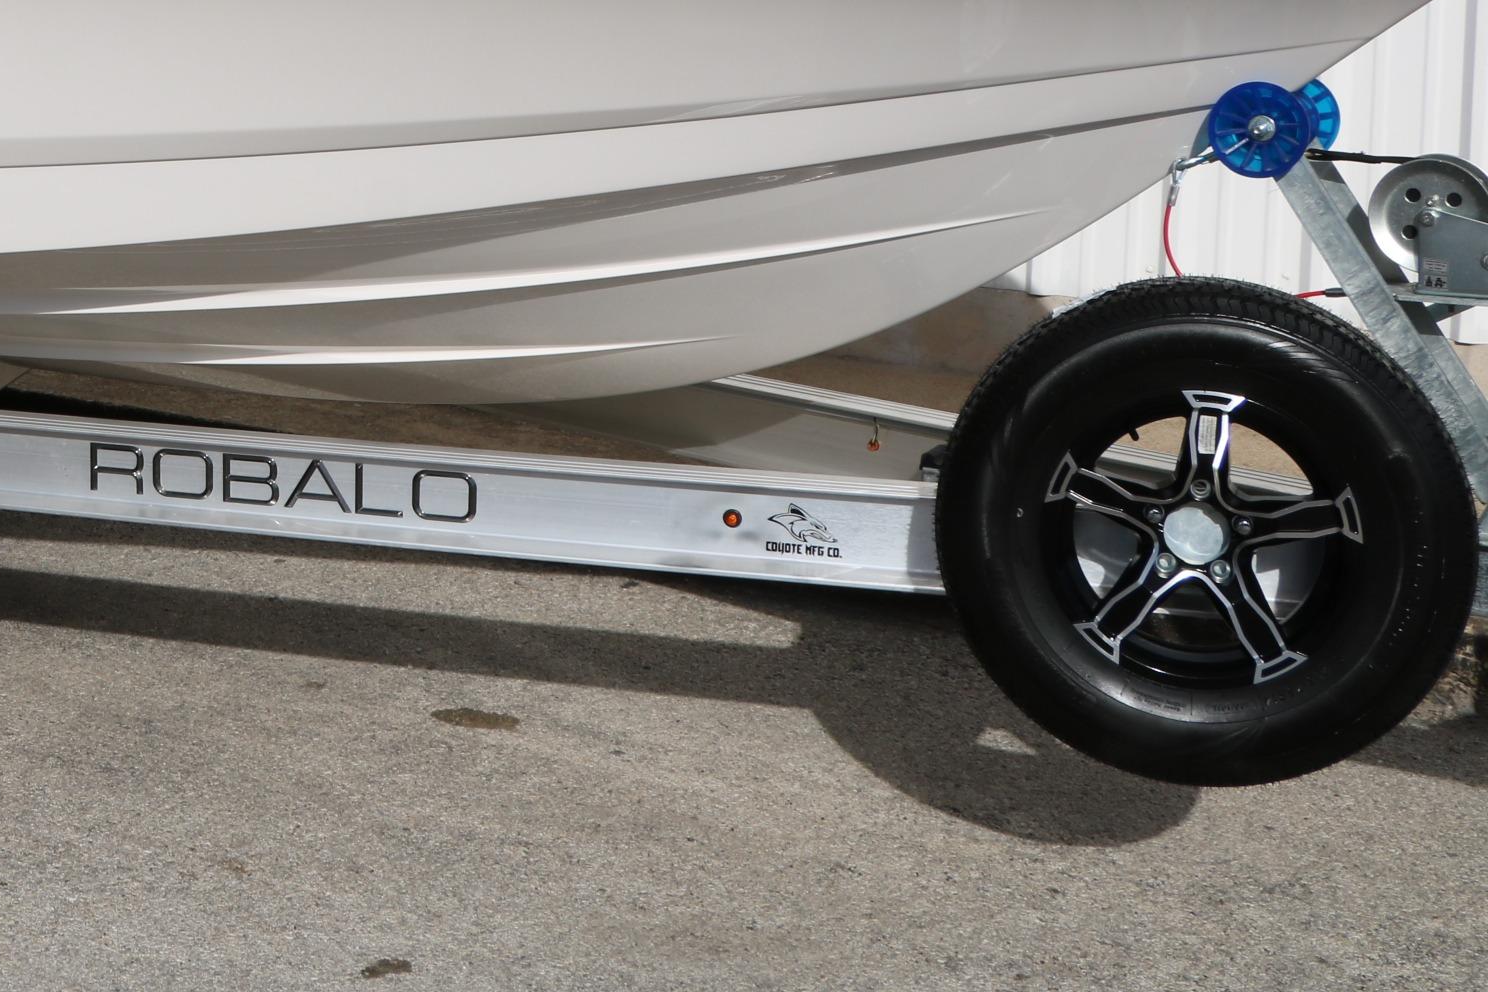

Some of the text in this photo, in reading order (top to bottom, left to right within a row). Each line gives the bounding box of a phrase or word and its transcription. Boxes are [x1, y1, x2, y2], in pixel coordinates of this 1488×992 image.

[90, 442, 478, 523] ROBALO
[765, 541, 843, 558] COYOTE MFG CO.
